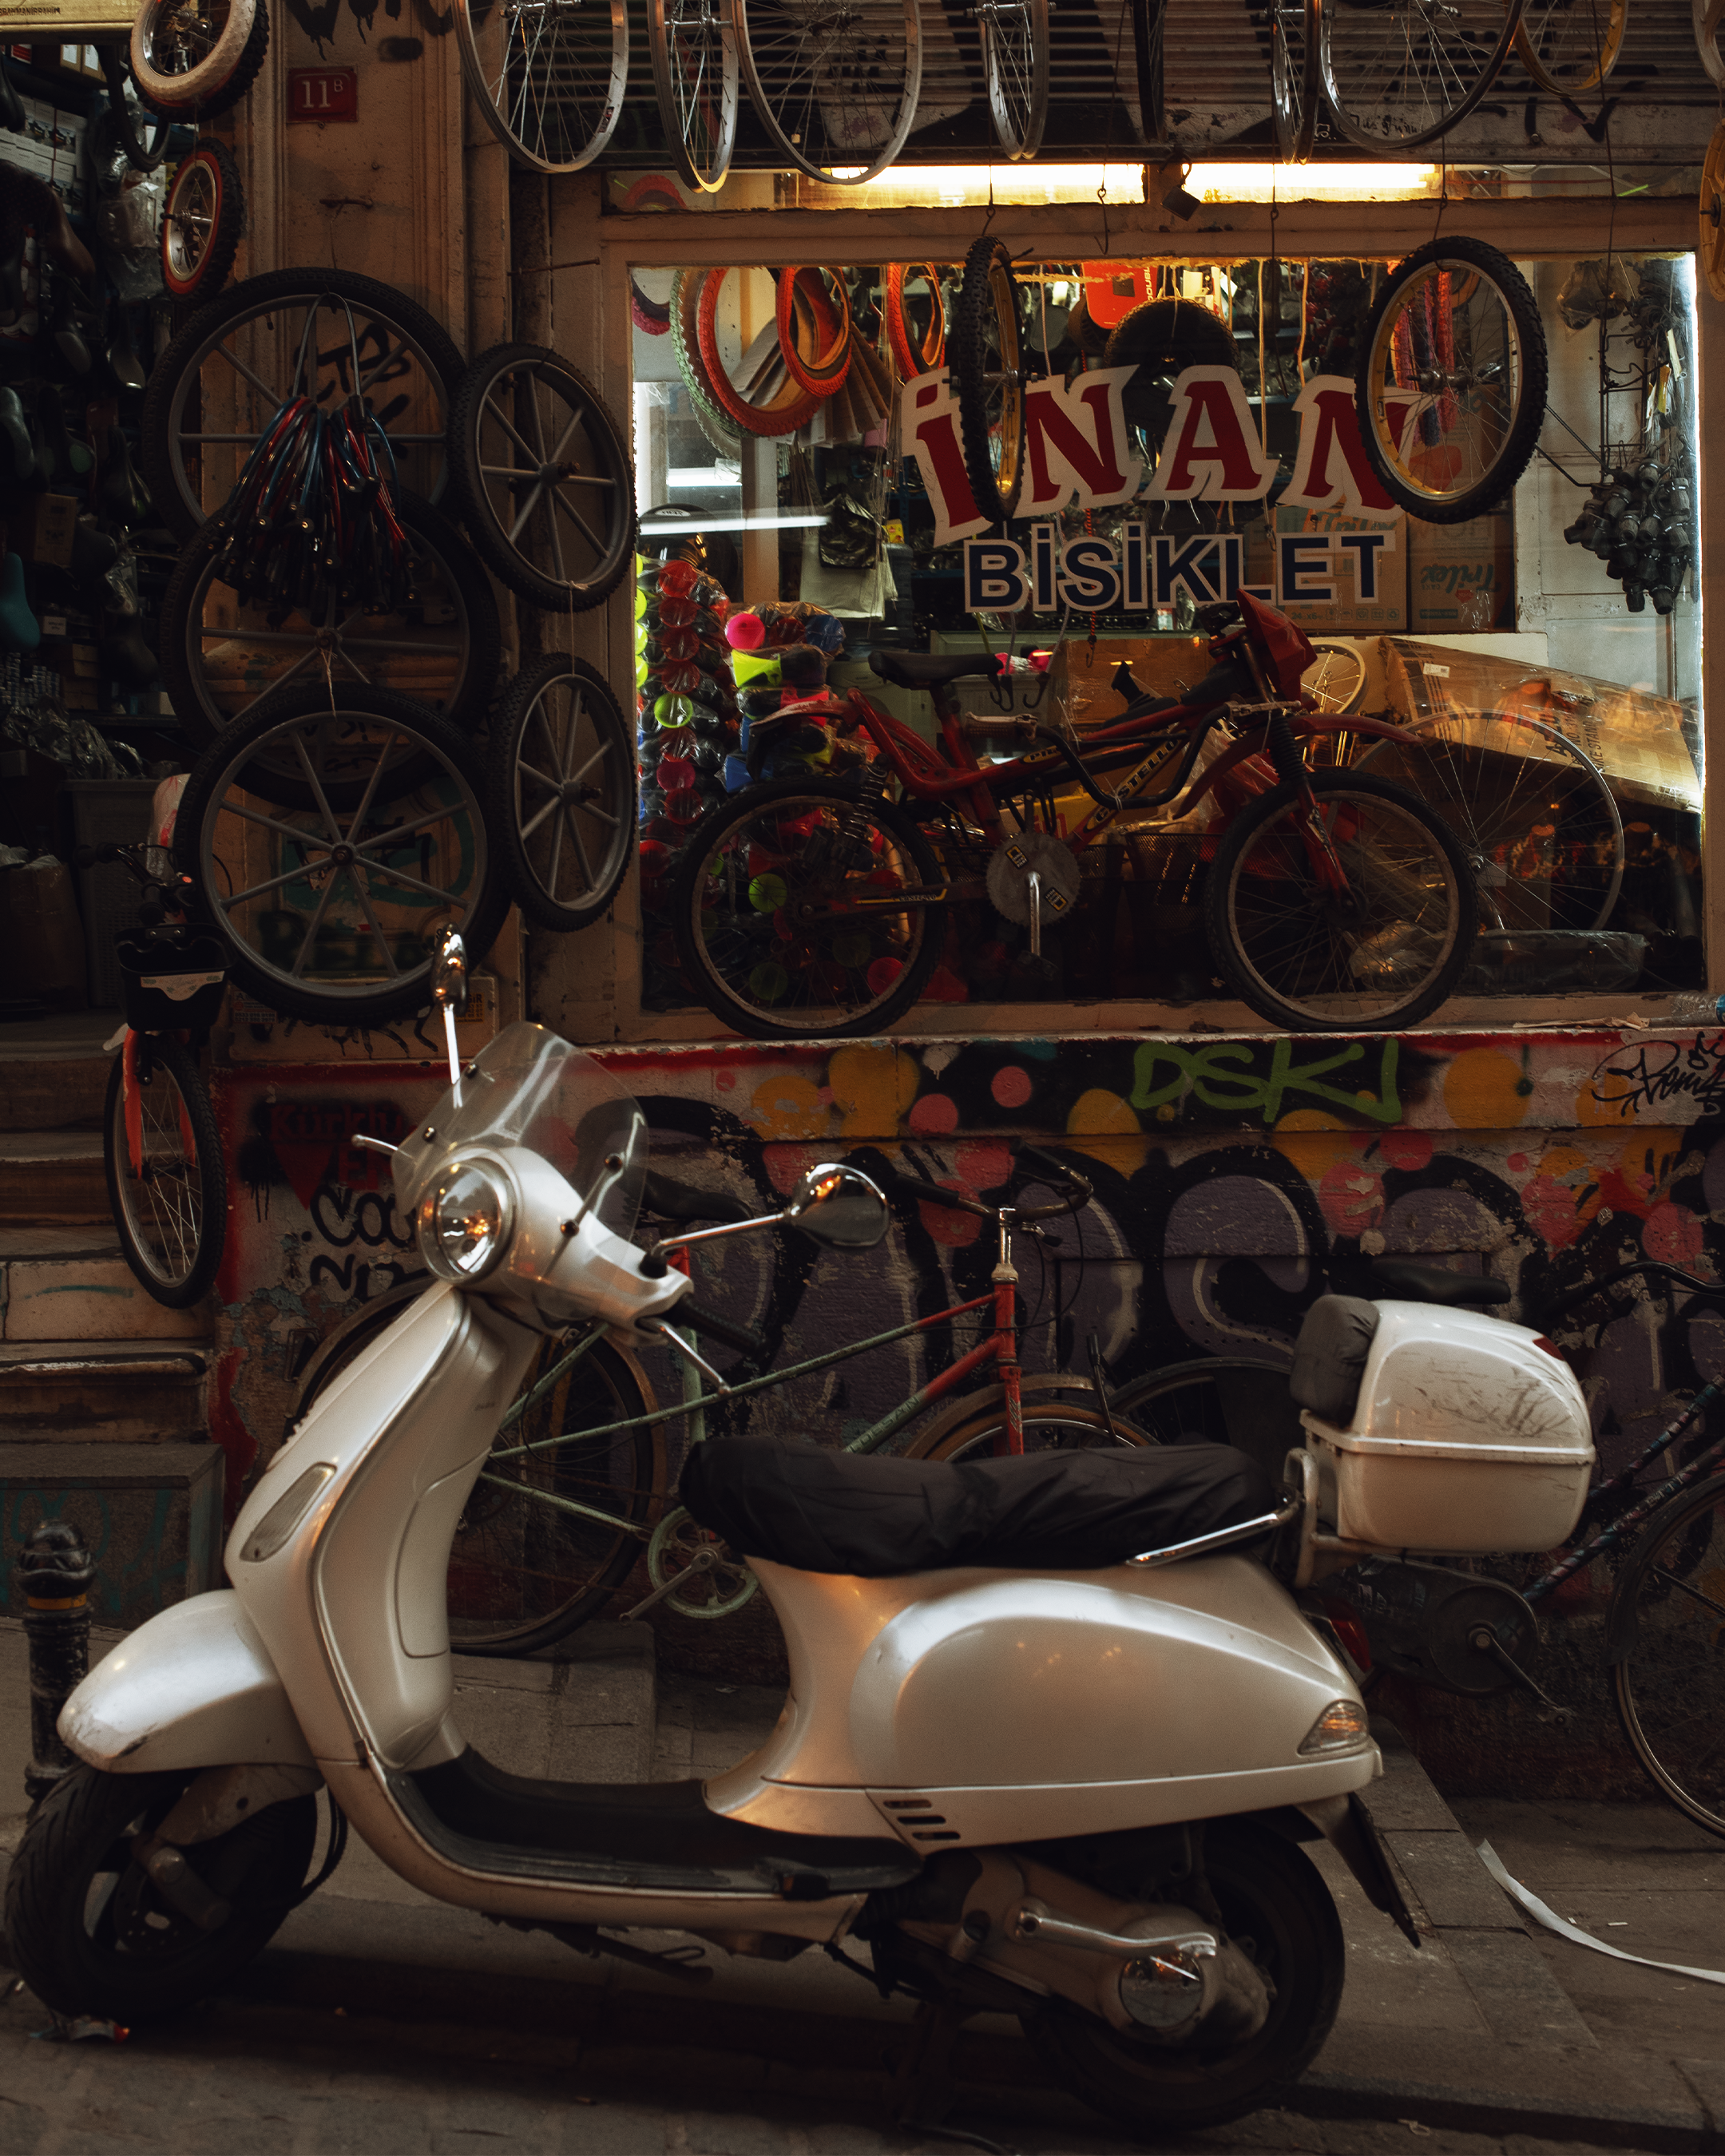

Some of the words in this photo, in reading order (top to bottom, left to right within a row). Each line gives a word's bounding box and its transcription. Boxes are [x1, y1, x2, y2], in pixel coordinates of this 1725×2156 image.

[1420, 563, 1501, 593] Trilex
[1094, 736, 1178, 824] CSTELLO
[269, 1103, 403, 1142] Kürklü
